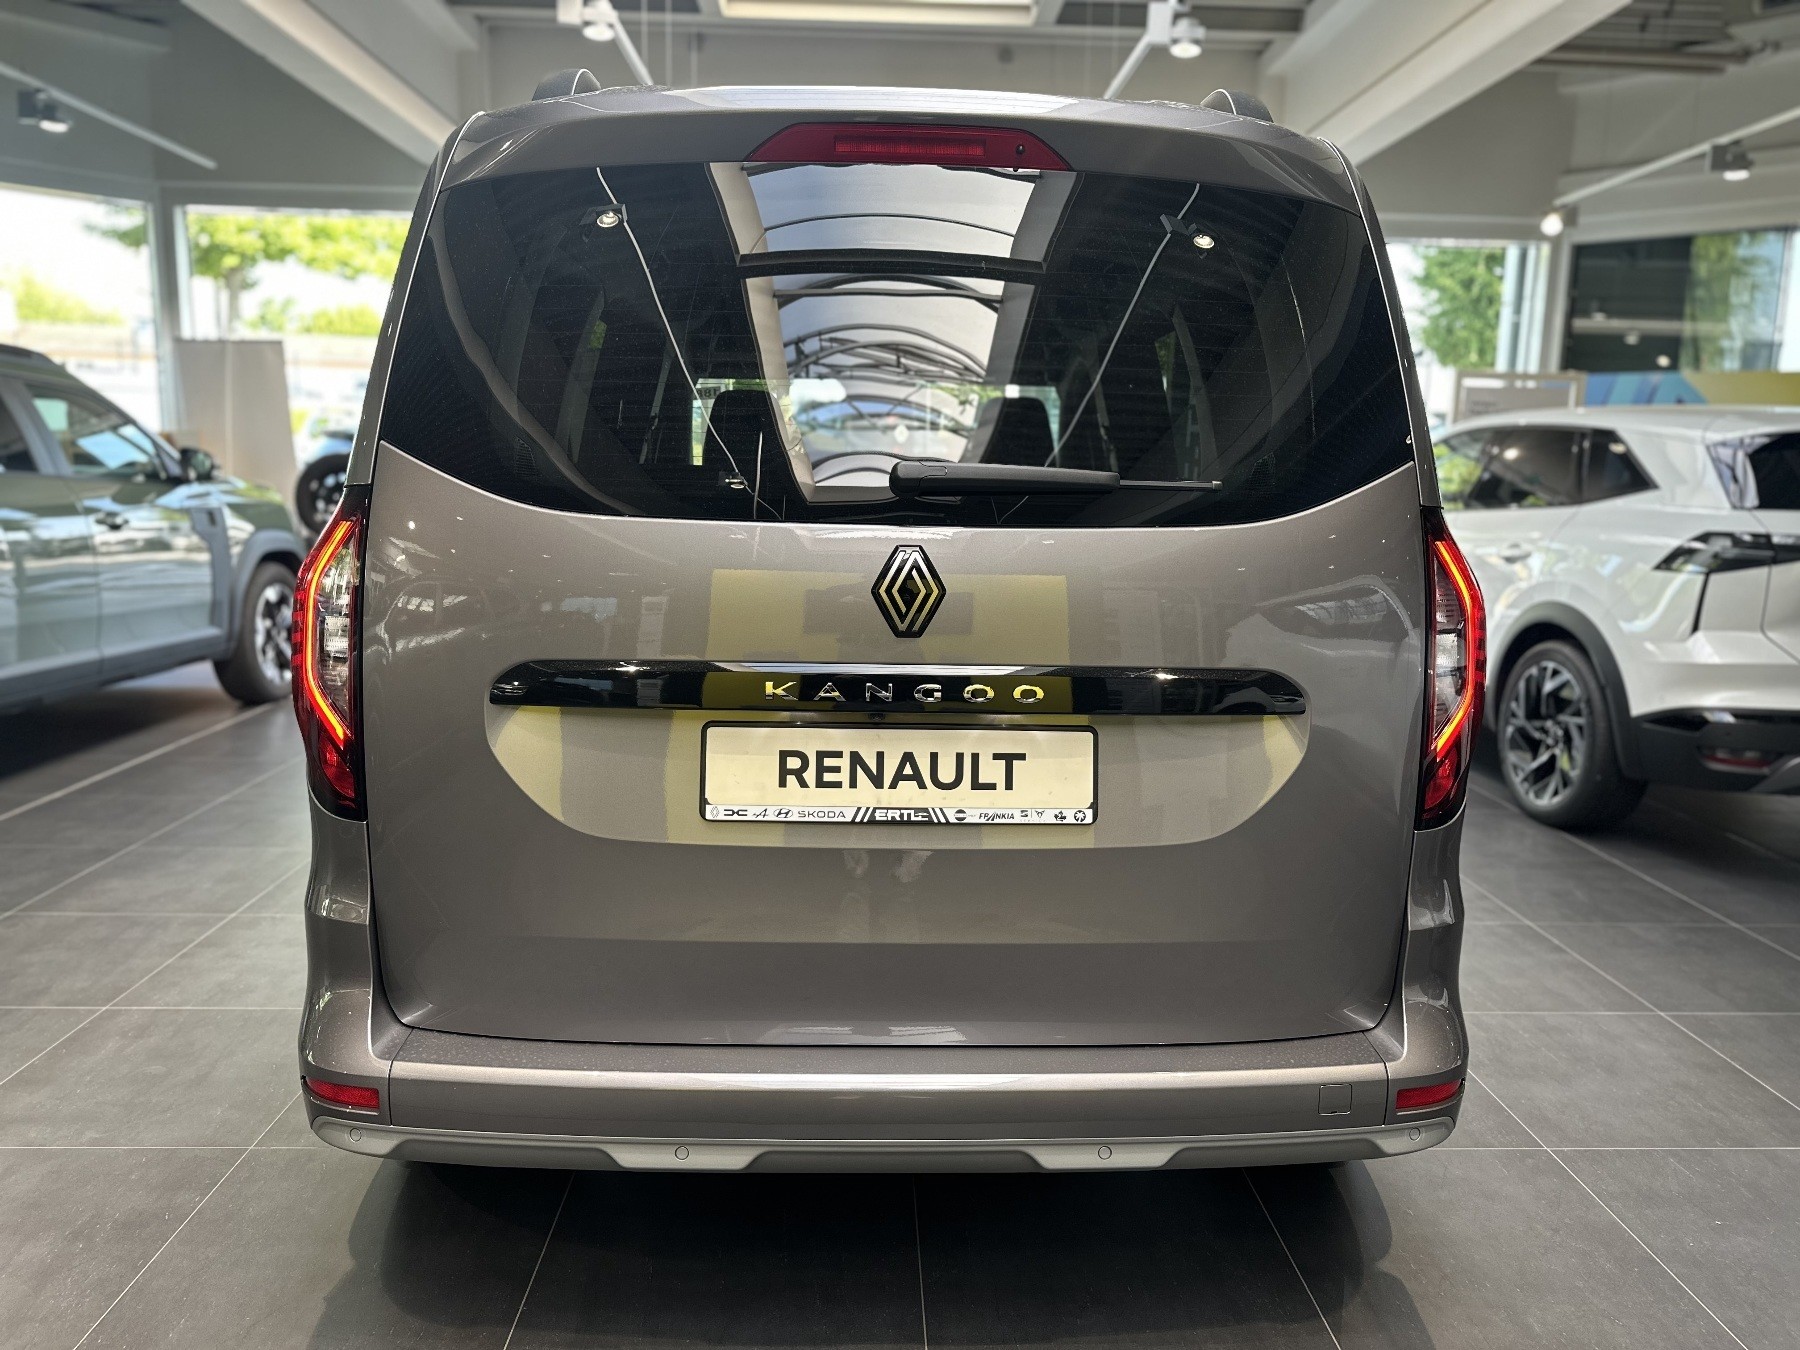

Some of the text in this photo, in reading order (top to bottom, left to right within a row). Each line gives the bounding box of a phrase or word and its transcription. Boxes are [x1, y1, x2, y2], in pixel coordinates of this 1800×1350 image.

[765, 681, 1045, 703] KANGOO
[778, 749, 1027, 791] RENAULT
[797, 810, 847, 819] SKODA
